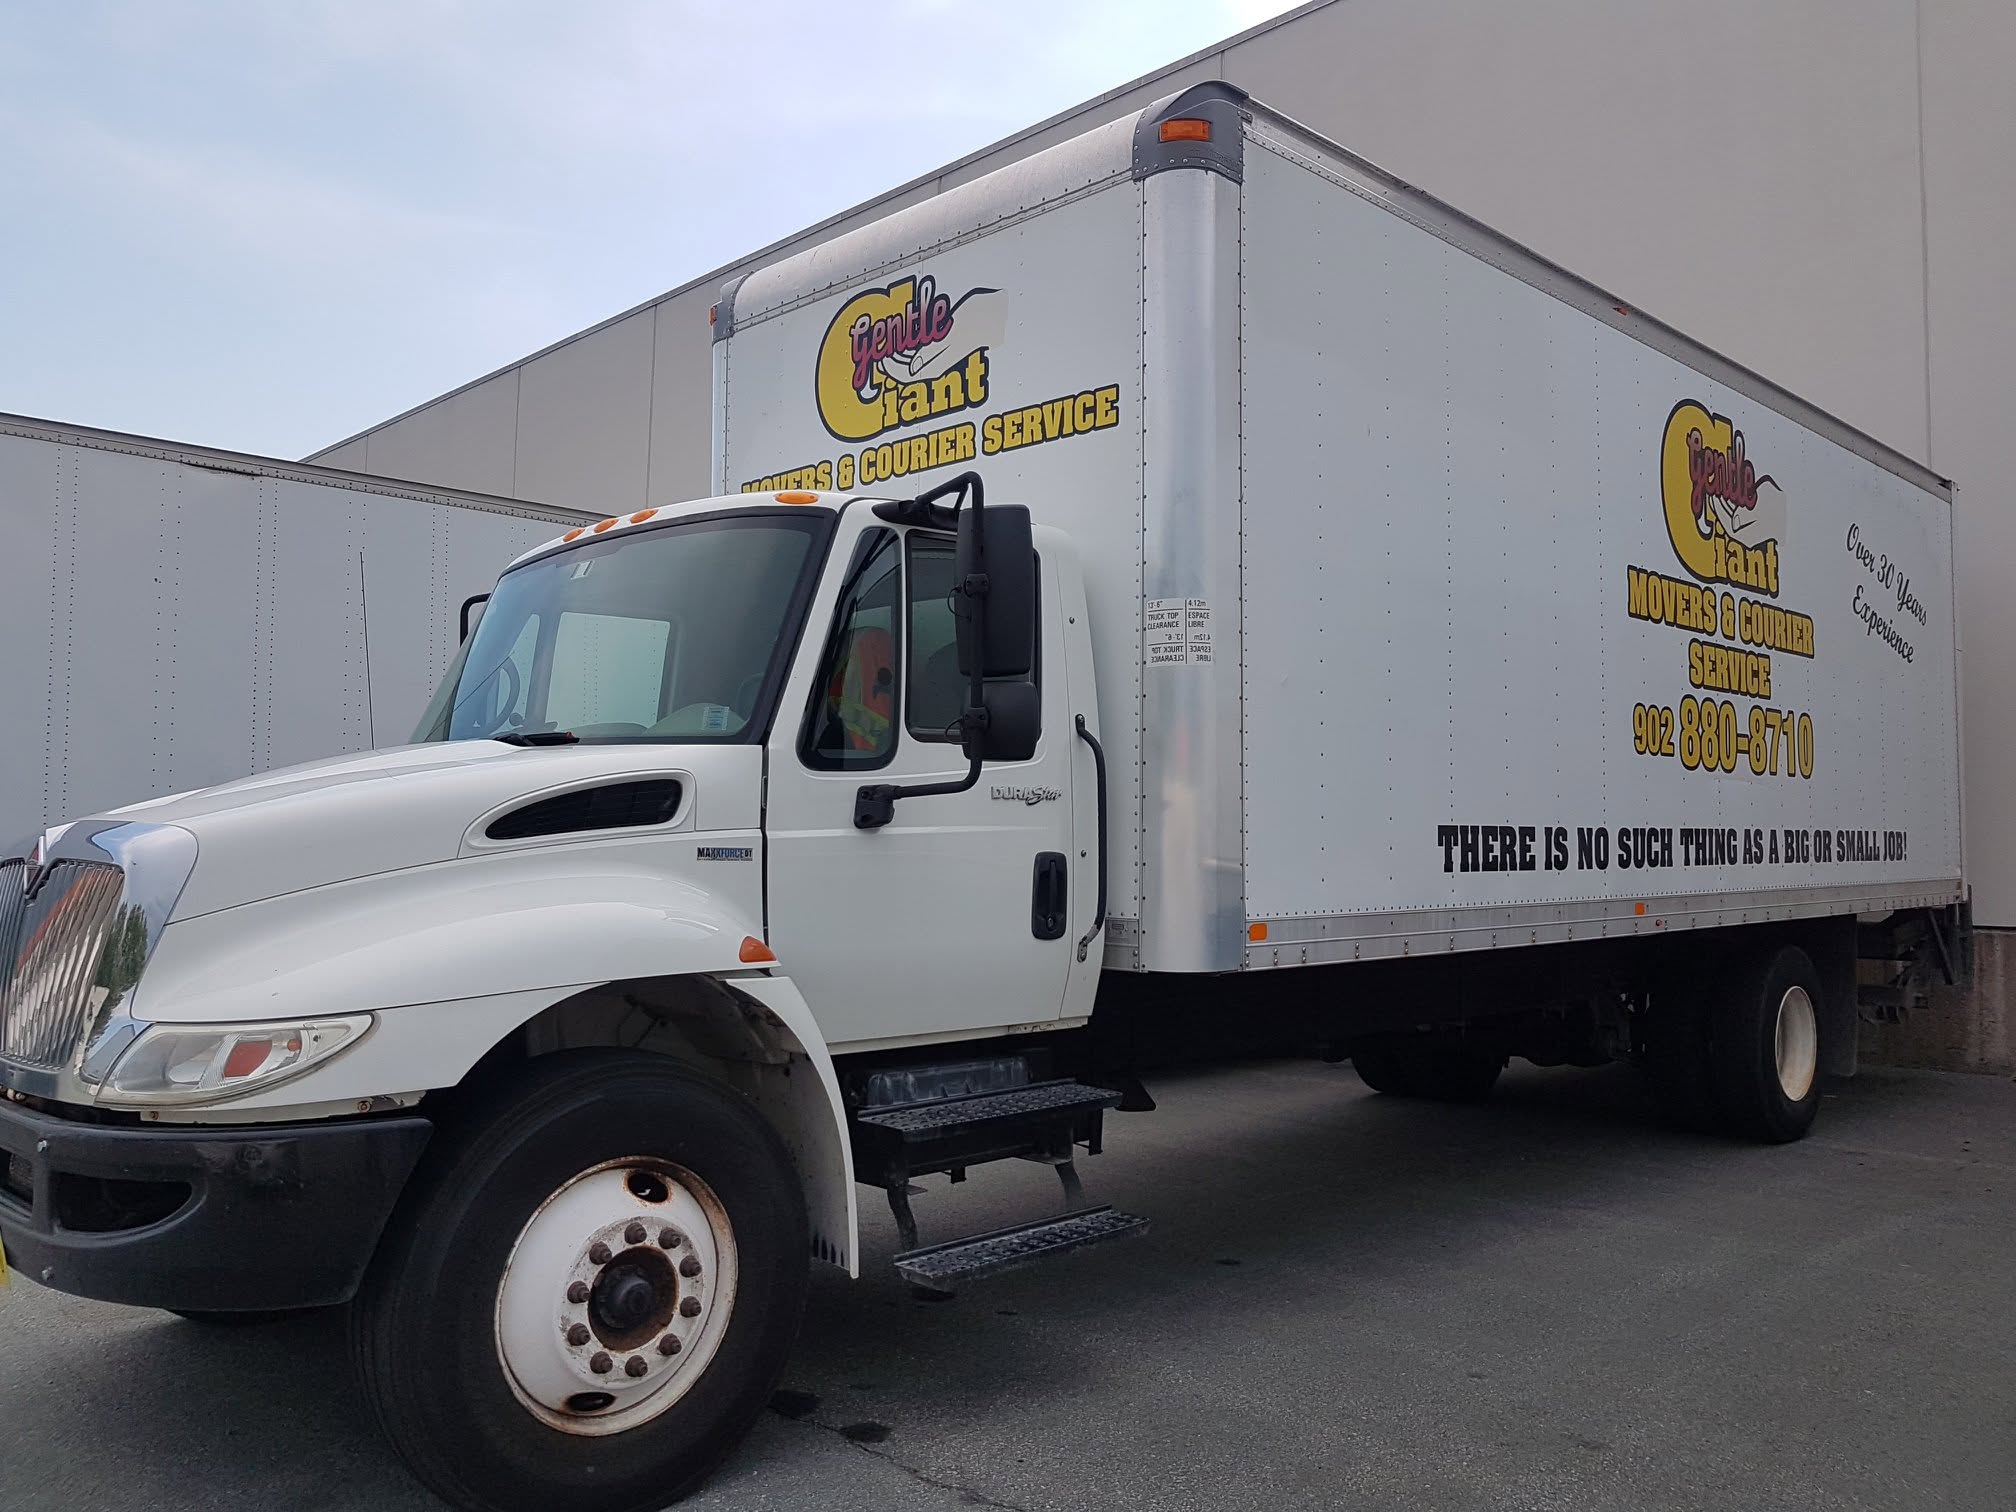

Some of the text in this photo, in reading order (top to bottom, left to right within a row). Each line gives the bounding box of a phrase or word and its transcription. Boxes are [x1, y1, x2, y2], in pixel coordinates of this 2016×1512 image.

[815, 274, 989, 444] Giant
[850, 275, 953, 389] Gentle
[836, 453, 855, 491] &
[859, 422, 977, 485] COURIER
[981, 384, 1120, 455] SERVICE
[1686, 427, 1757, 521] Gentle
[1660, 398, 1780, 598] Giant
[1188, 611, 1210, 620] ESPACE
[1627, 564, 1815, 659] MOVERS & COURIER
[1846, 522, 1927, 626] Over 30 Years
[1147, 621, 1180, 630] CLEARANCE
[1188, 620, 1205, 628] LIBRE
[1852, 584, 1914, 664] Experience
[1688, 638, 1771, 700] SERVICE
[1633, 694, 1814, 779] 902 880-8710
[1437, 825, 1908, 873] THERE IS NO SUCH THING AS A BIG OR SMALL JOB!
